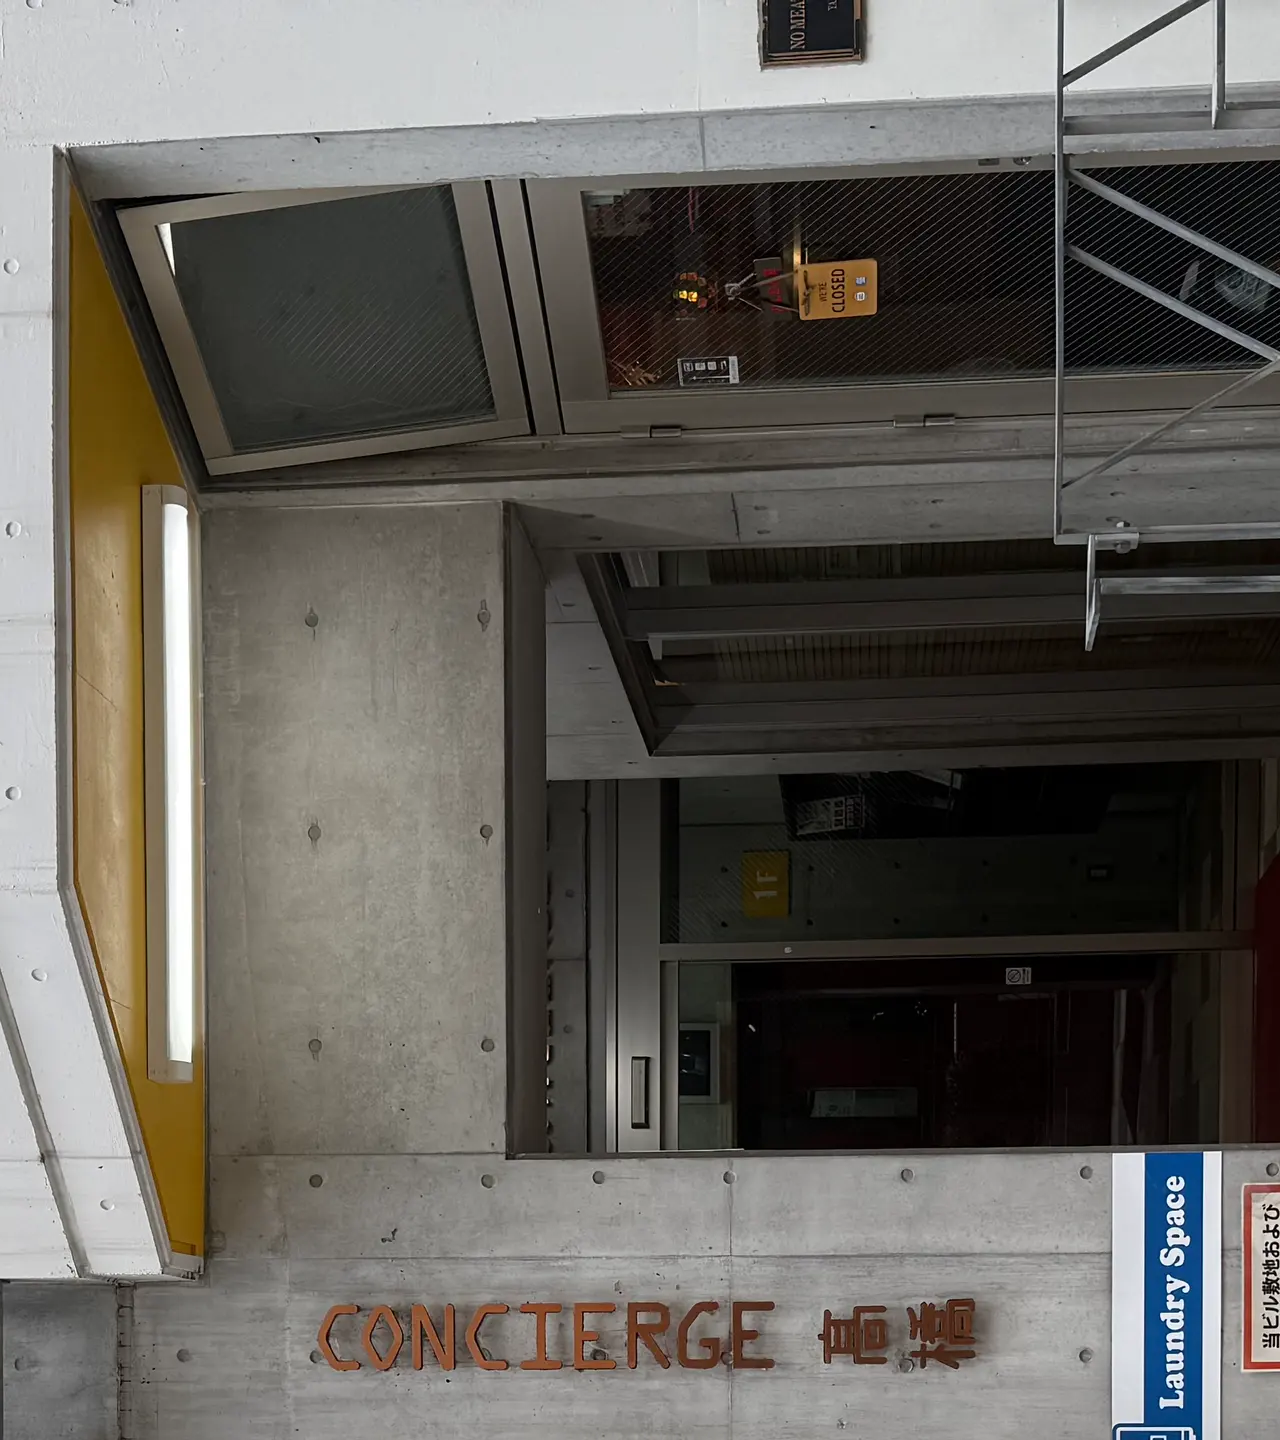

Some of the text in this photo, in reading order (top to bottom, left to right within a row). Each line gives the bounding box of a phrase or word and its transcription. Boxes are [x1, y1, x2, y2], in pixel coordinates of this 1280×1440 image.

[790, 0, 806, 50] NO MEA
[830, 268, 846, 313] CLOSED
[752, 870, 778, 899] 1F
[1159, 1175, 1191, 1410] Laundry Space
[318, 1301, 776, 1372] CONCIERGE
